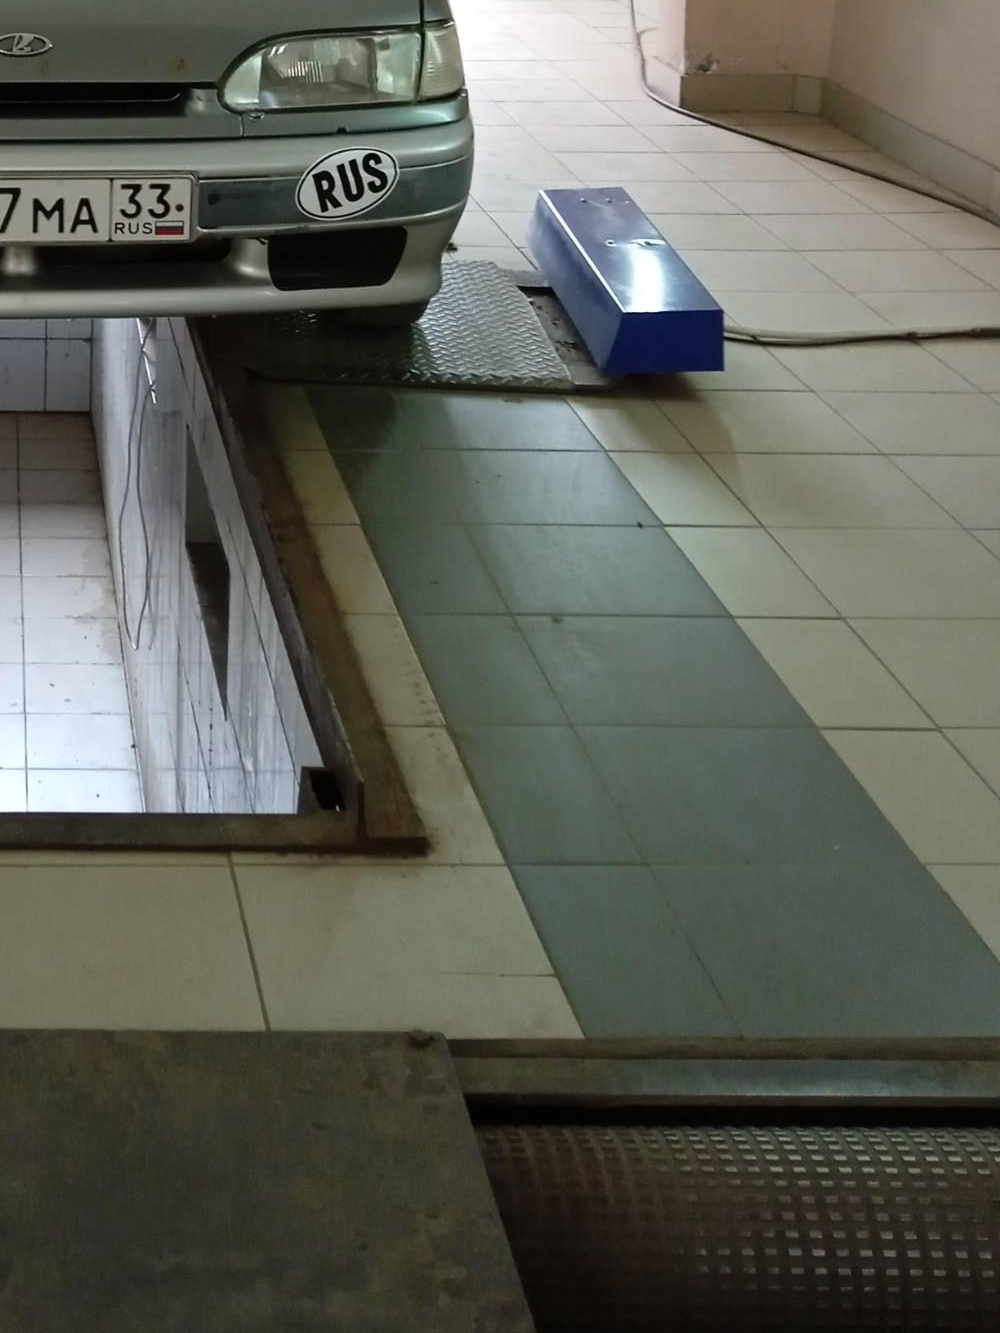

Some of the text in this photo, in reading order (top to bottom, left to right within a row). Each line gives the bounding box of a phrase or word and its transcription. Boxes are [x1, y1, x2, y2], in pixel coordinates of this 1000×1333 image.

[119, 183, 172, 217] 33
[313, 152, 390, 214] RUS
[114, 221, 153, 236] RUS
